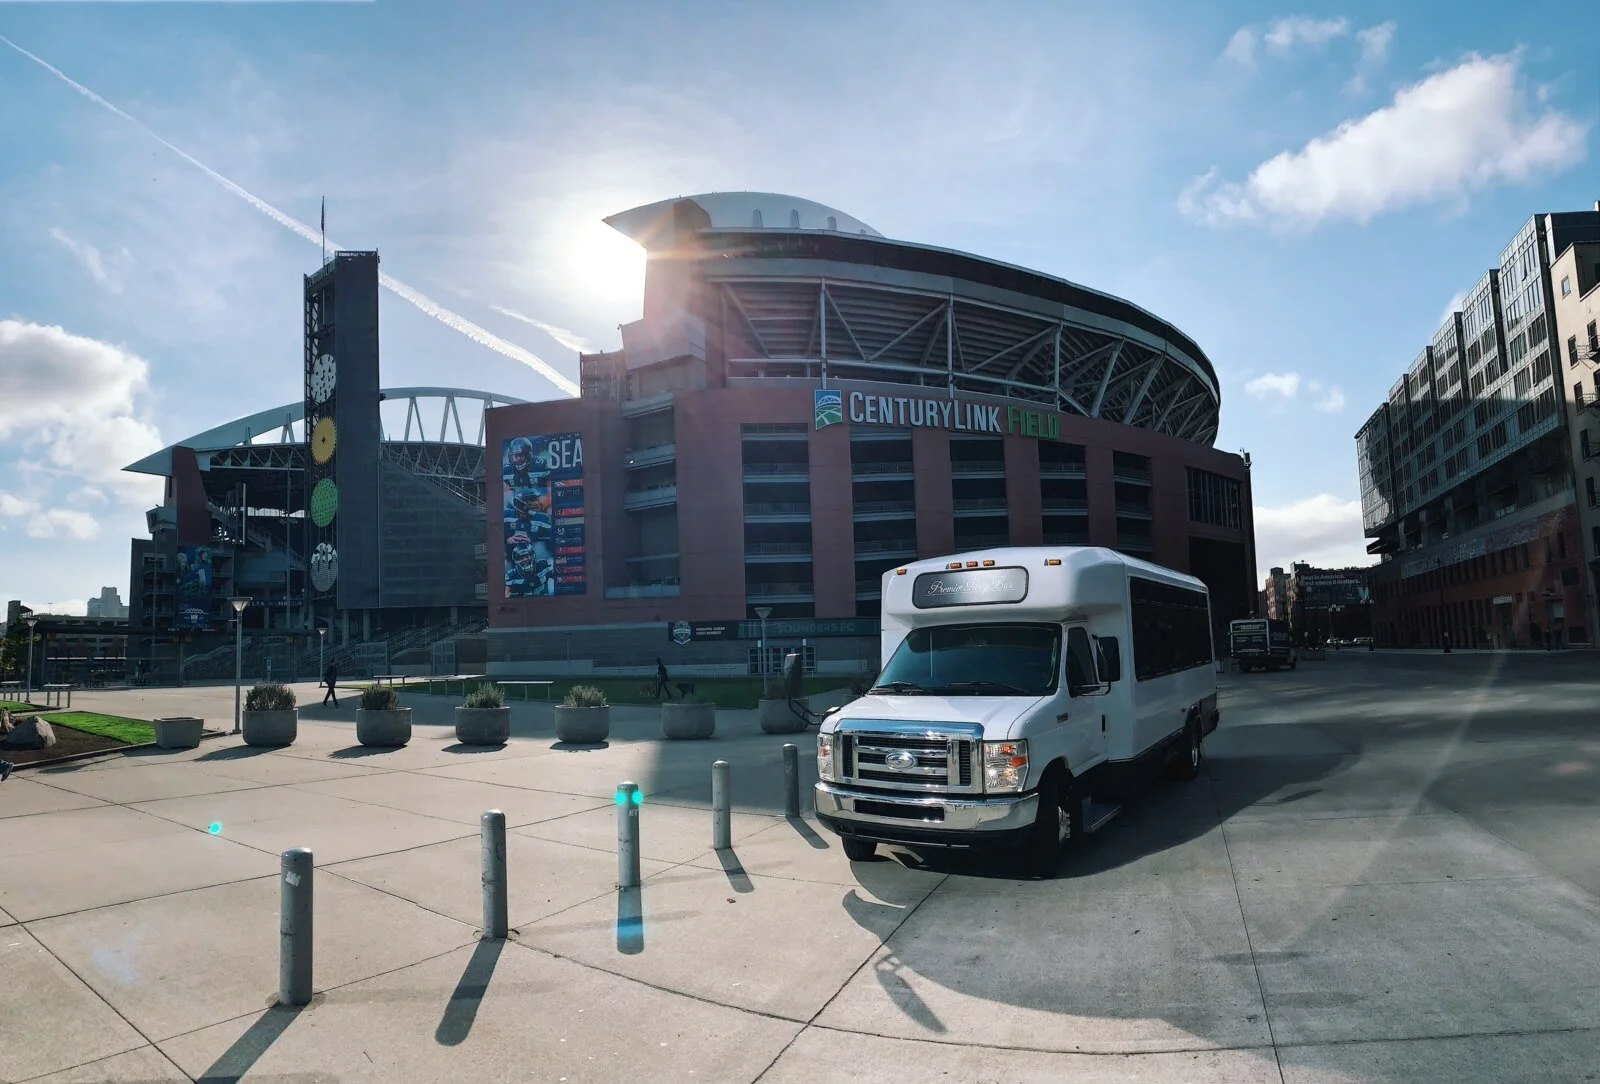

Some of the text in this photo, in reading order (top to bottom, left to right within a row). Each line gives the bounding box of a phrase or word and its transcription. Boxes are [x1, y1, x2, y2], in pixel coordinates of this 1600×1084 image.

[547, 438, 583, 470] SEA
[994, 575, 1014, 590] Bus
[776, 622, 855, 634] SOUNDERS FC
